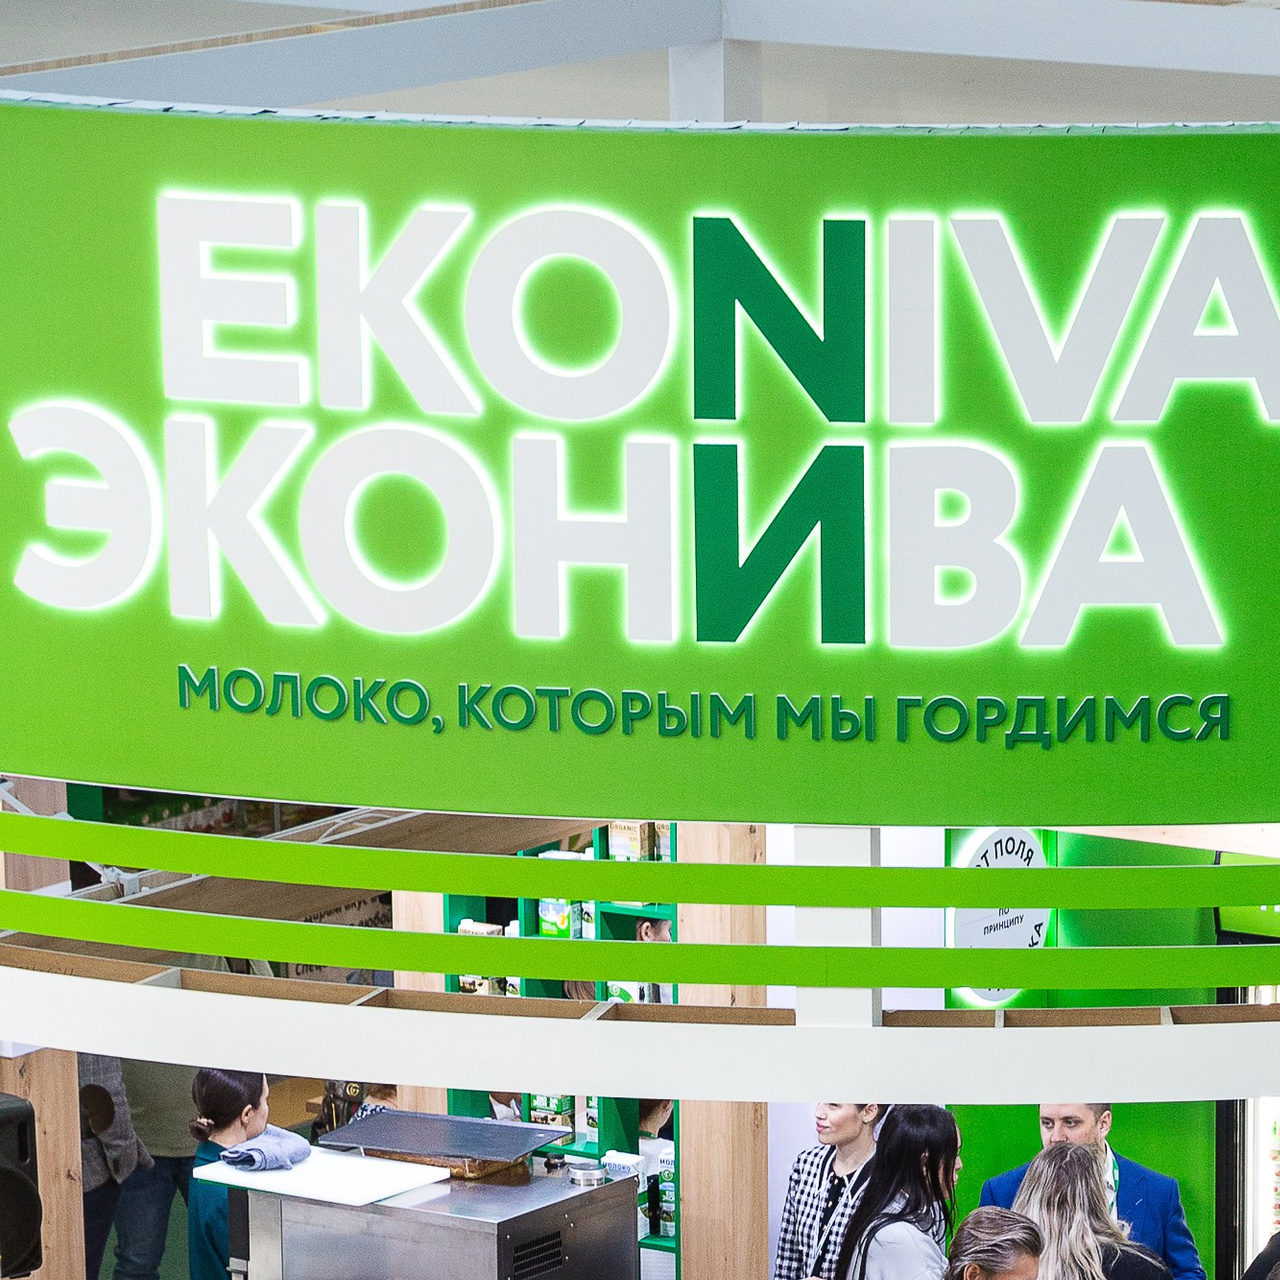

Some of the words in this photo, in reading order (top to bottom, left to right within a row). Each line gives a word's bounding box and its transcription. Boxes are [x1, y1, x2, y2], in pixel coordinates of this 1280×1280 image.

[8, 404, 1226, 647] ЭКОНИВА
[177, 665, 444, 734] МОЛОКО,
[457, 684, 756, 738] КОТОРЫМ
[776, 695, 875, 742] МЫ
[896, 695, 1233, 751] ГОРДИМСЯ
[994, 836, 1034, 866] ПОЛЯ
[983, 914, 1025, 936] ПРИНЦИПУ
